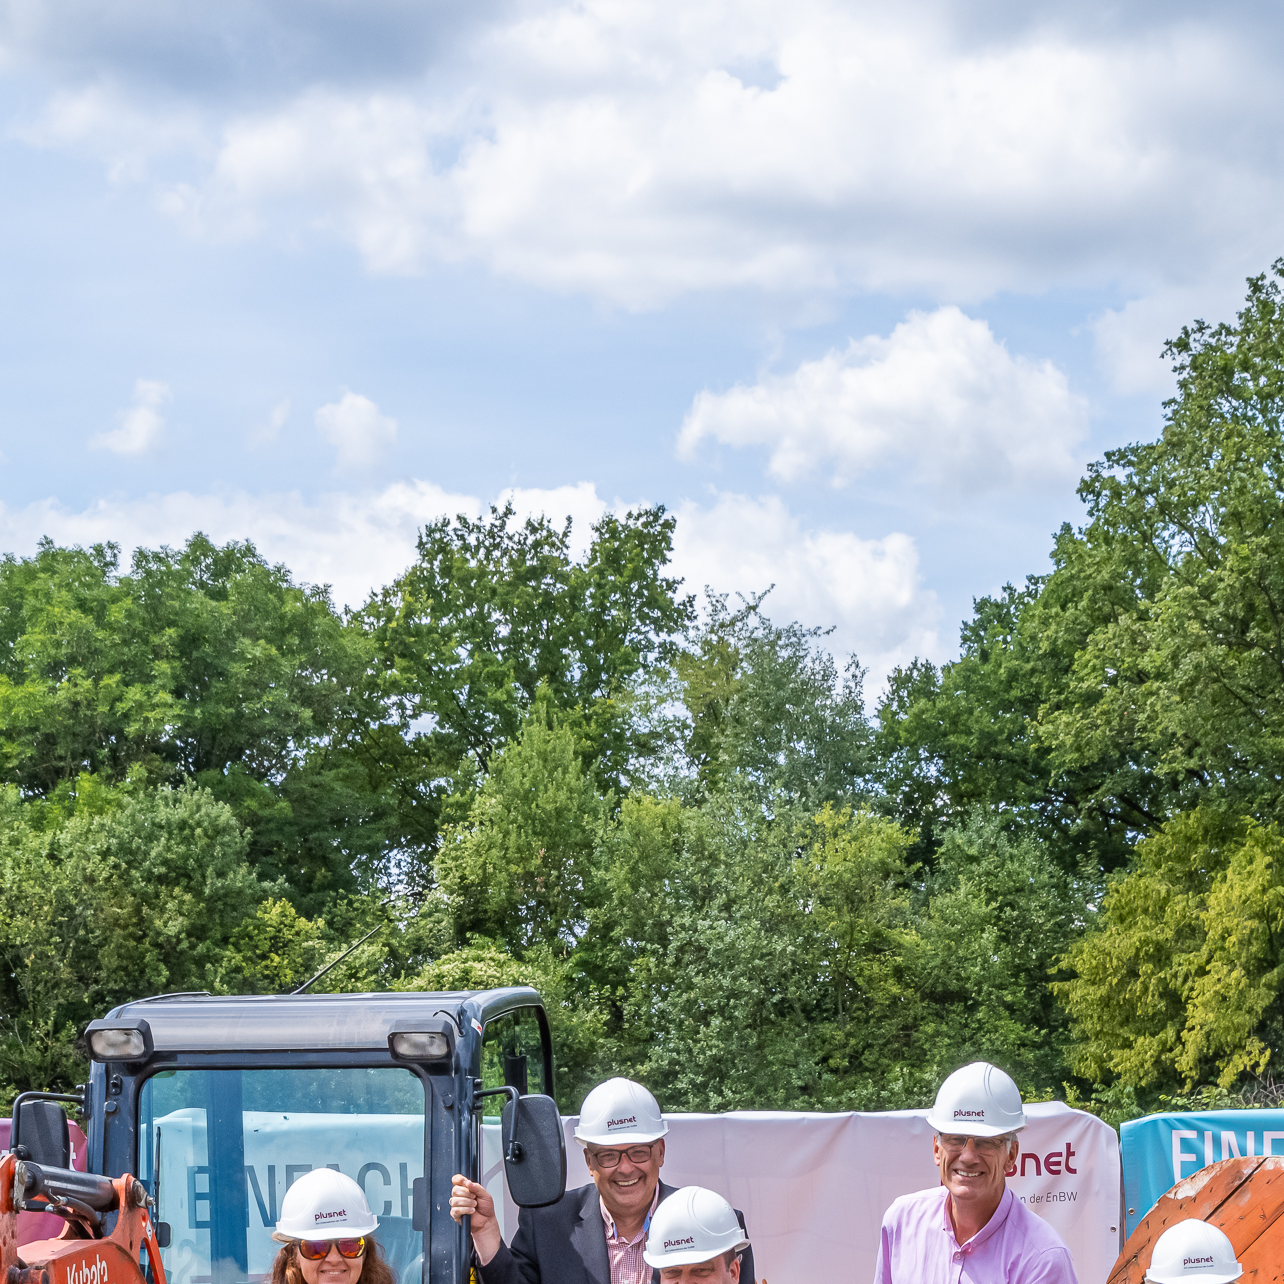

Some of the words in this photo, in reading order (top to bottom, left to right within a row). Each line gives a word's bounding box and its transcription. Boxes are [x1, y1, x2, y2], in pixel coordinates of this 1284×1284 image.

[953, 1109, 984, 1118] plusnet
[607, 1115, 636, 1128] plusnet
[1029, 1194, 1044, 1204] der
[1045, 1191, 1078, 1203] EnBW
[314, 1209, 347, 1221] plusnet
[663, 1236, 694, 1249] plusnet
[1183, 1255, 1213, 1266] plusnet
